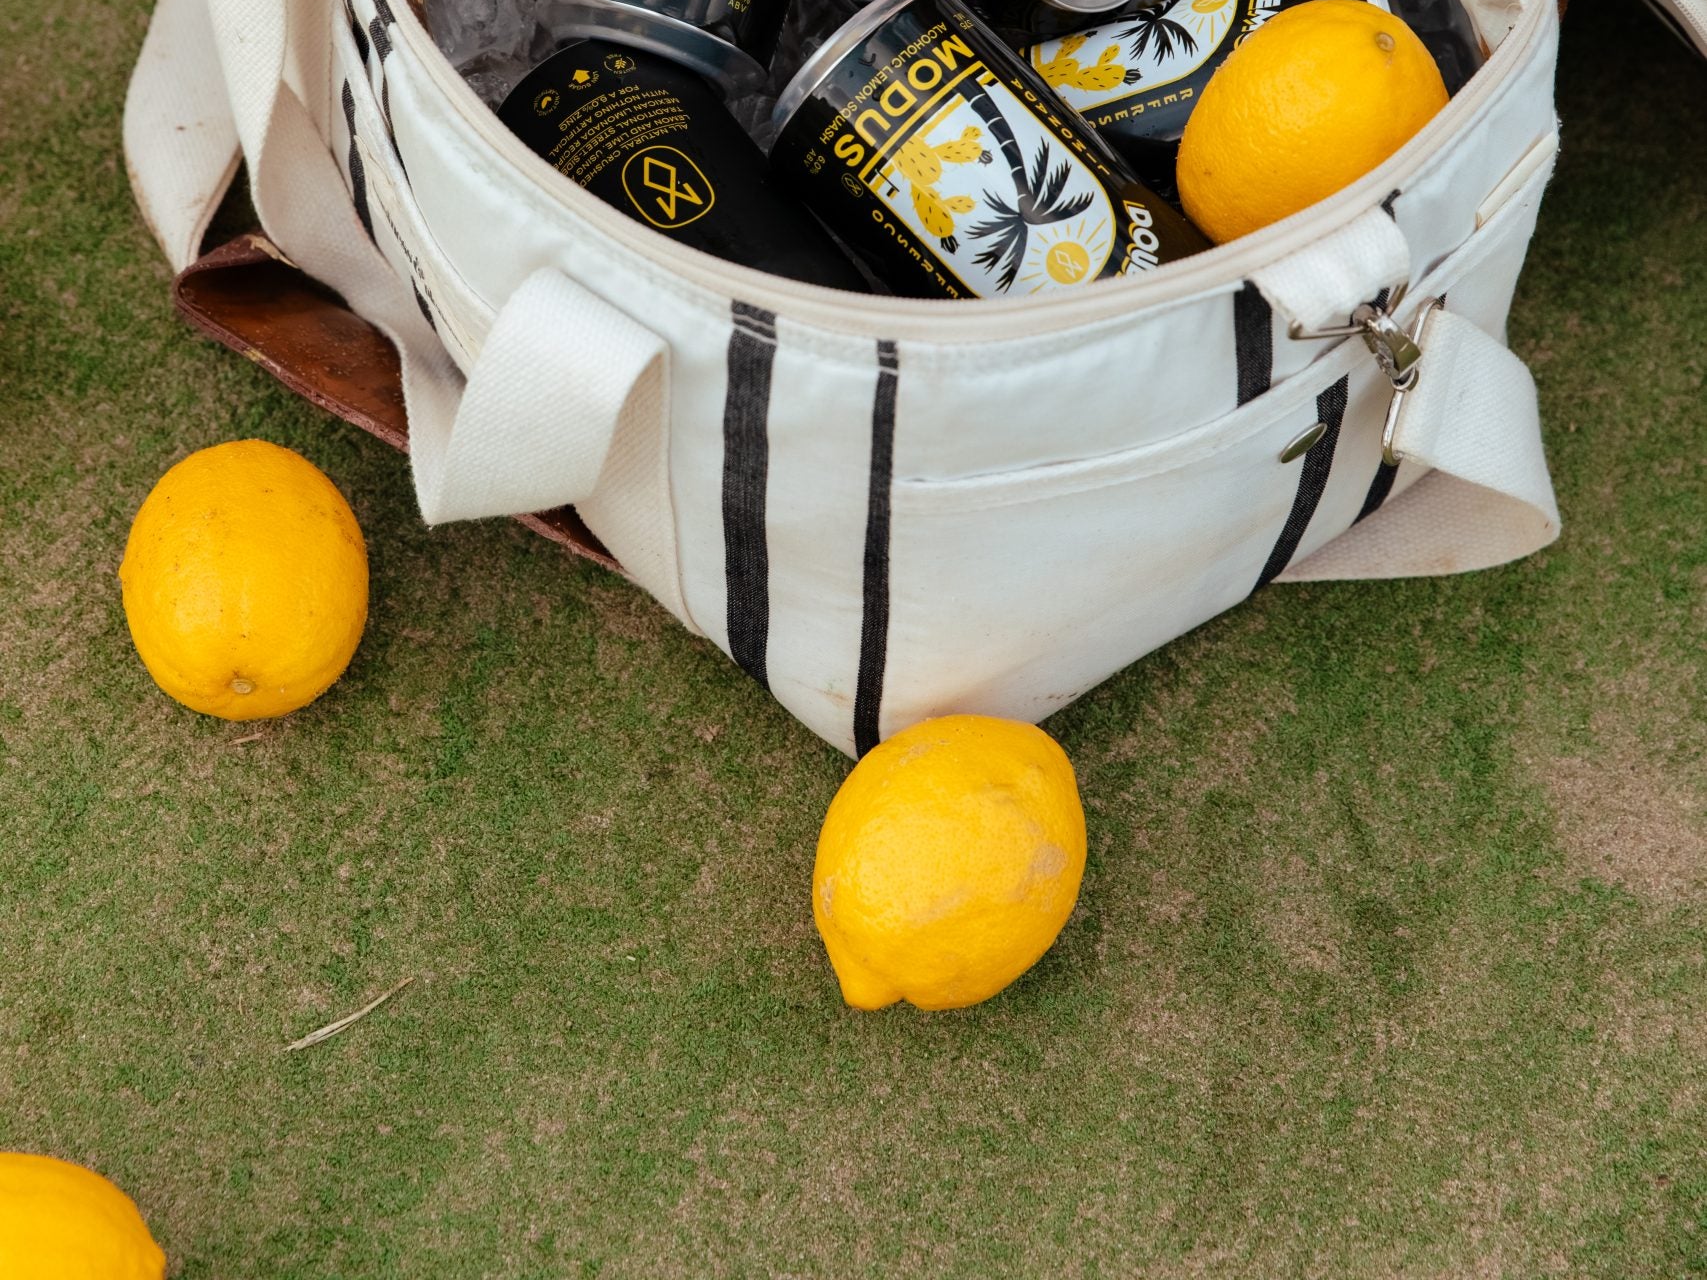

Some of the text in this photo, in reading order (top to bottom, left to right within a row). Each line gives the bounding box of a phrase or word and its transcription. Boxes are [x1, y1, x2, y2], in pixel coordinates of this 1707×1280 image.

[728, 0, 747, 13] ABV
[618, 84, 640, 96] FOR
[819, 22, 947, 144] ALCOHOLIC LEMON SQUASH
[634, 97, 680, 112] MEXICAN
[834, 34, 975, 167] MODUS
[549, 89, 669, 157] WITH NOTHING ARTIFICIAL
[559, 111, 582, 132] ZING
[581, 107, 632, 140] LIMONADA
[630, 123, 651, 135] AND
[654, 114, 691, 125] LEMON
[1011, 78, 1110, 175] LIMONADA
[561, 107, 684, 176] TRADITIONAL STREET-SIDE
[580, 122, 688, 188] ALL NATURAL CRUSHED
[803, 148, 817, 167] ABV
[576, 150, 603, 175] USING
[872, 209, 959, 299] EFRESCO
[1121, 200, 1160, 275] DOU
